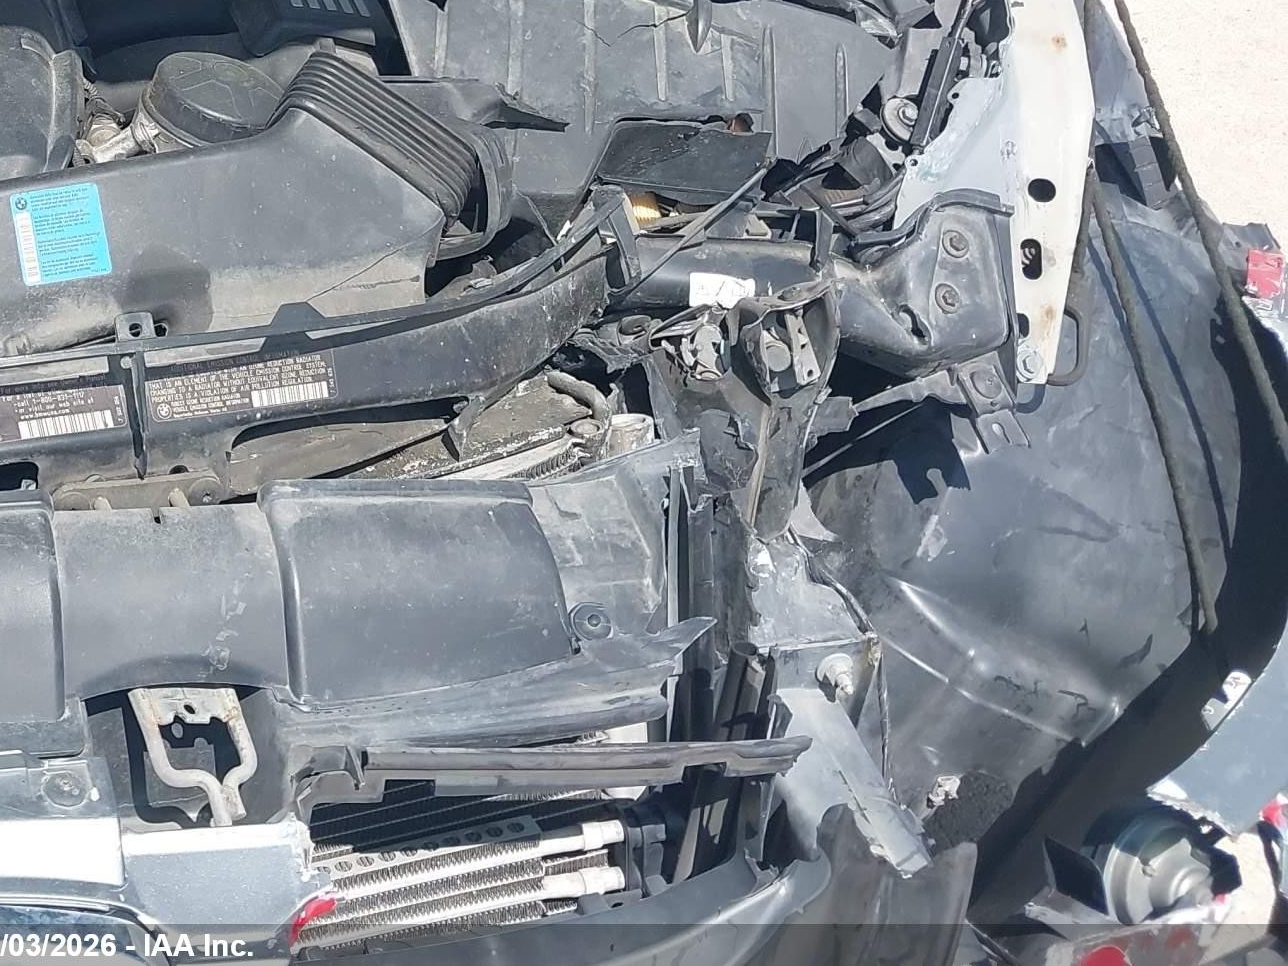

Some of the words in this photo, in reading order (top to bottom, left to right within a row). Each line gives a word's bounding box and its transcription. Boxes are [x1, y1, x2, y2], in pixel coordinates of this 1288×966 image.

[195, 381, 220, 391] RADIATOR
[223, 378, 245, 387] WITHOUT
[247, 373, 279, 384] EQUIVALENT
[200, 387, 229, 397] VIOLATION
[251, 380, 280, 390] POLLUTION
